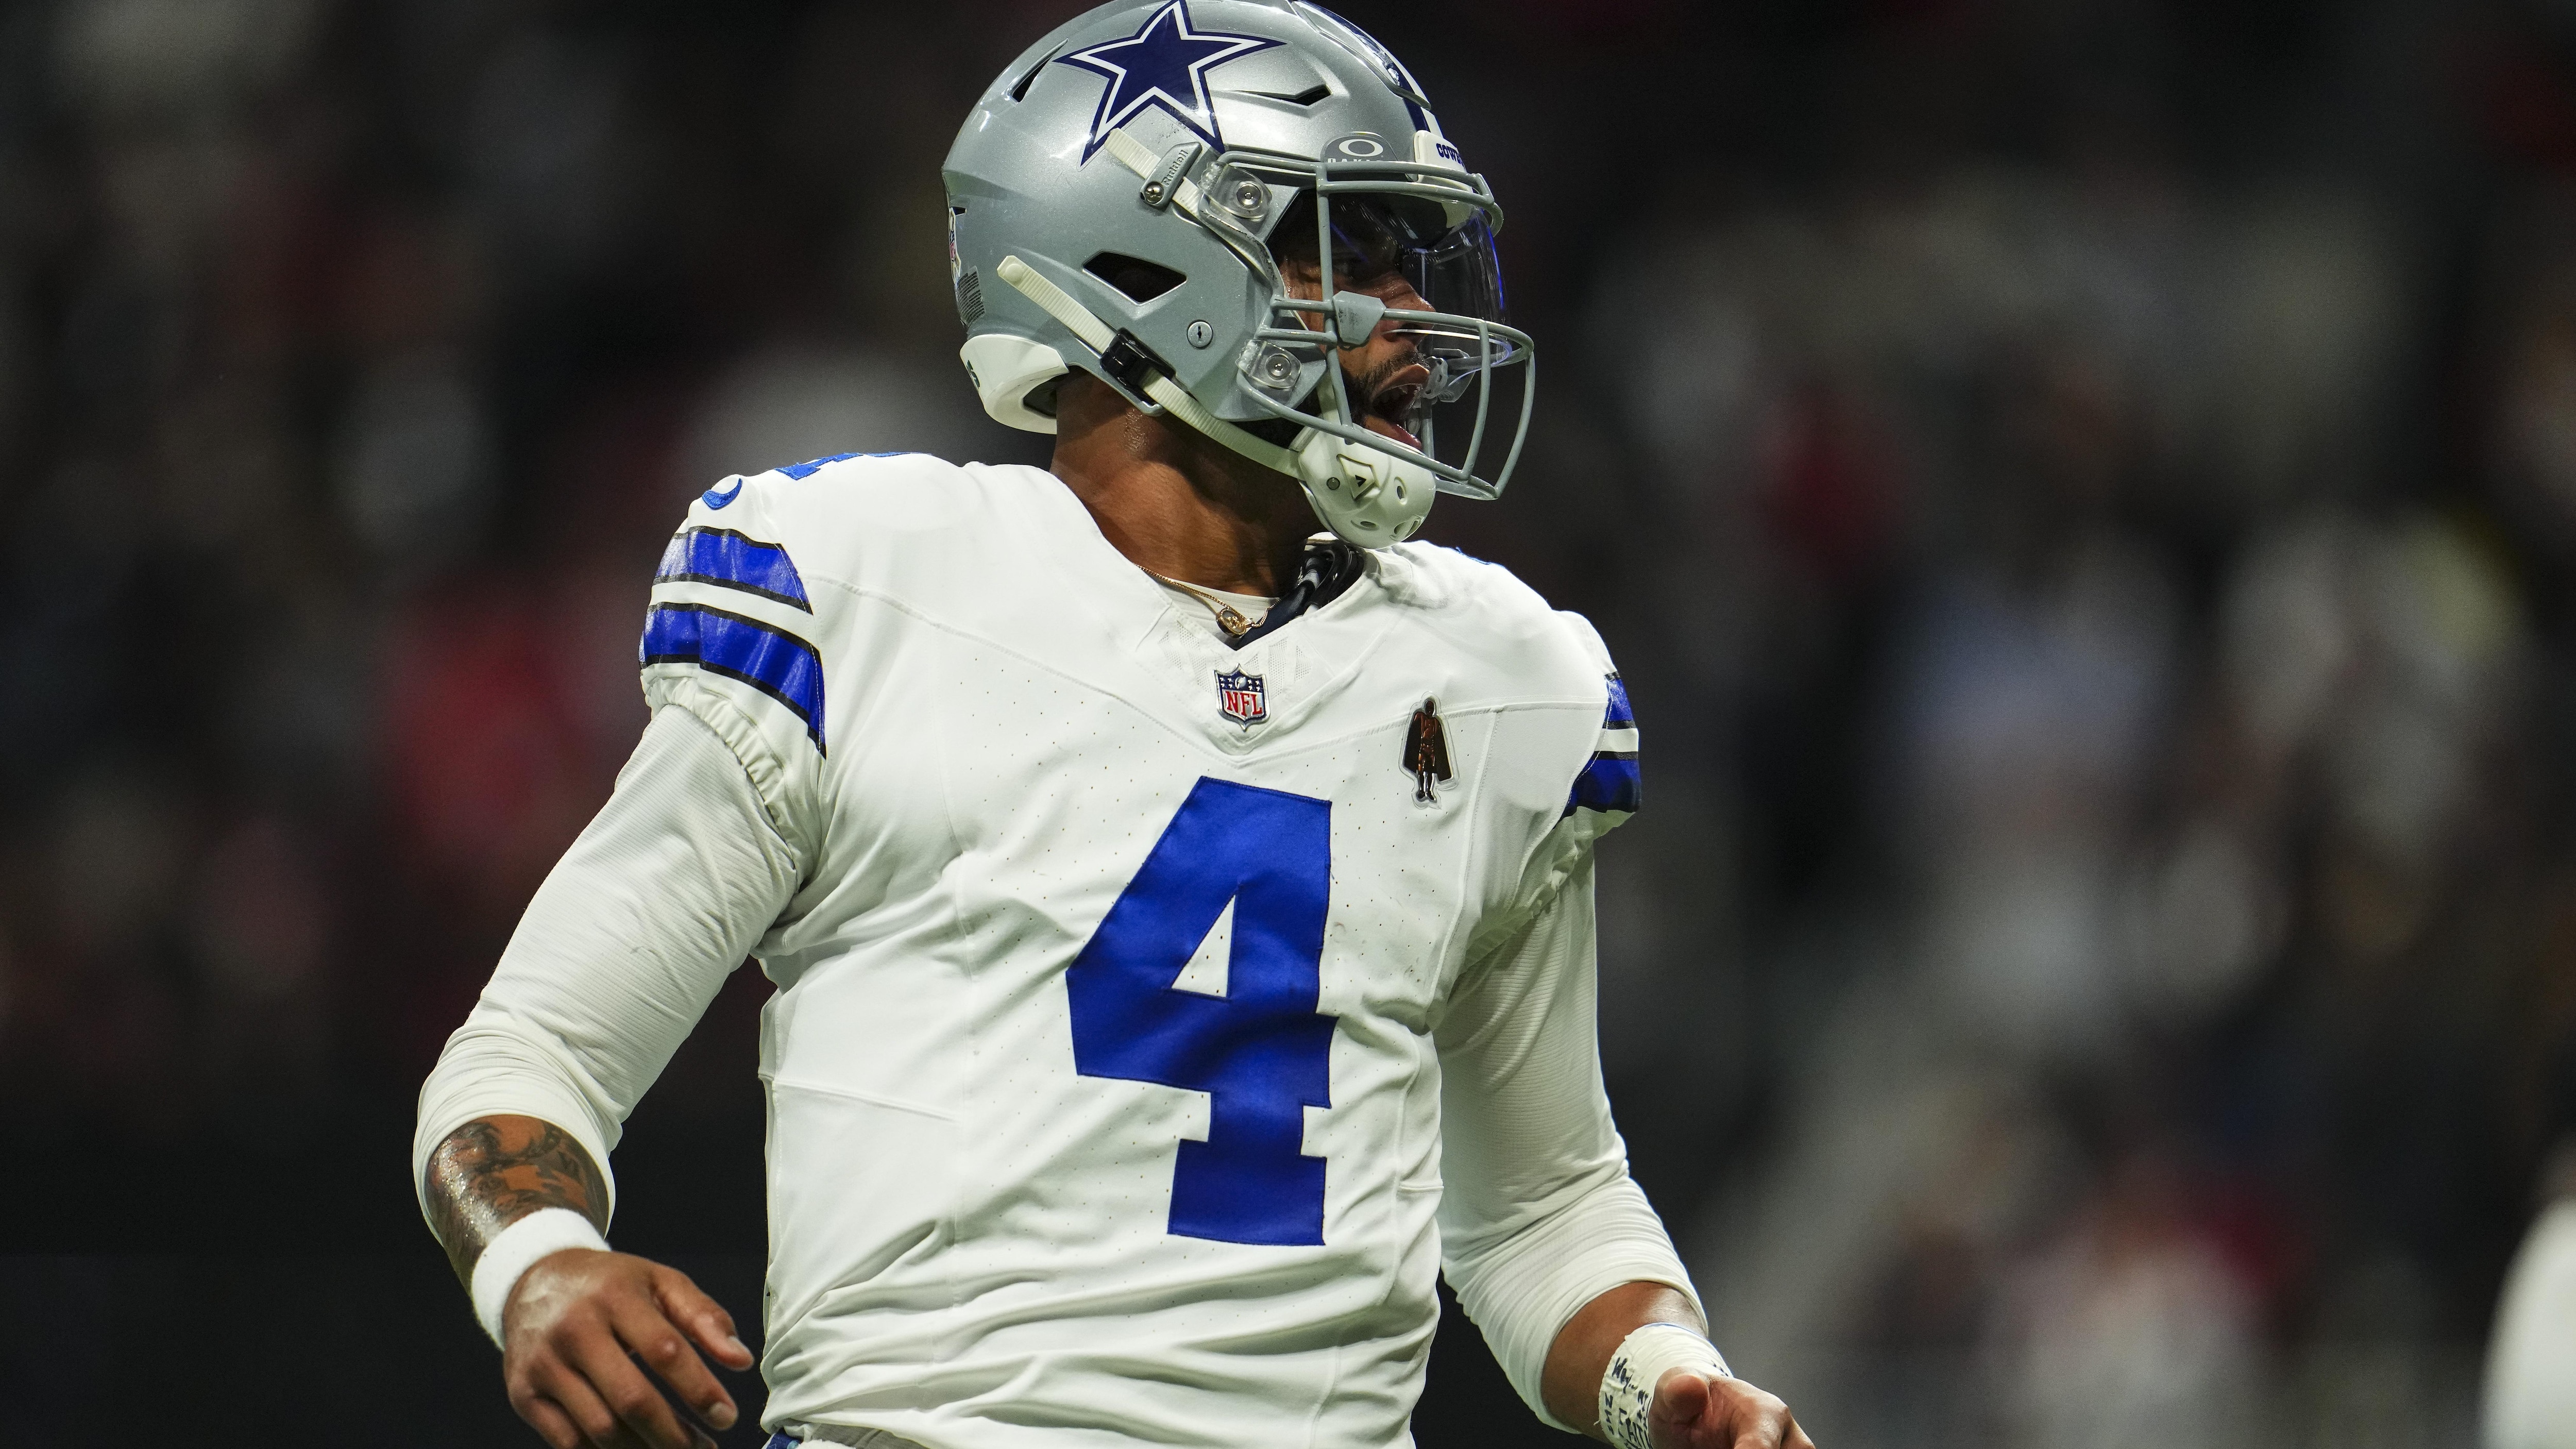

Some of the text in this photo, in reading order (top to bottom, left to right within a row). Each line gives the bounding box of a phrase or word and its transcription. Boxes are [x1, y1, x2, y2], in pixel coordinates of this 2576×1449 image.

[1161, 149, 1189, 186] Riddell
[1224, 690, 1263, 717] NFL
[1066, 776, 1339, 1246] 4
